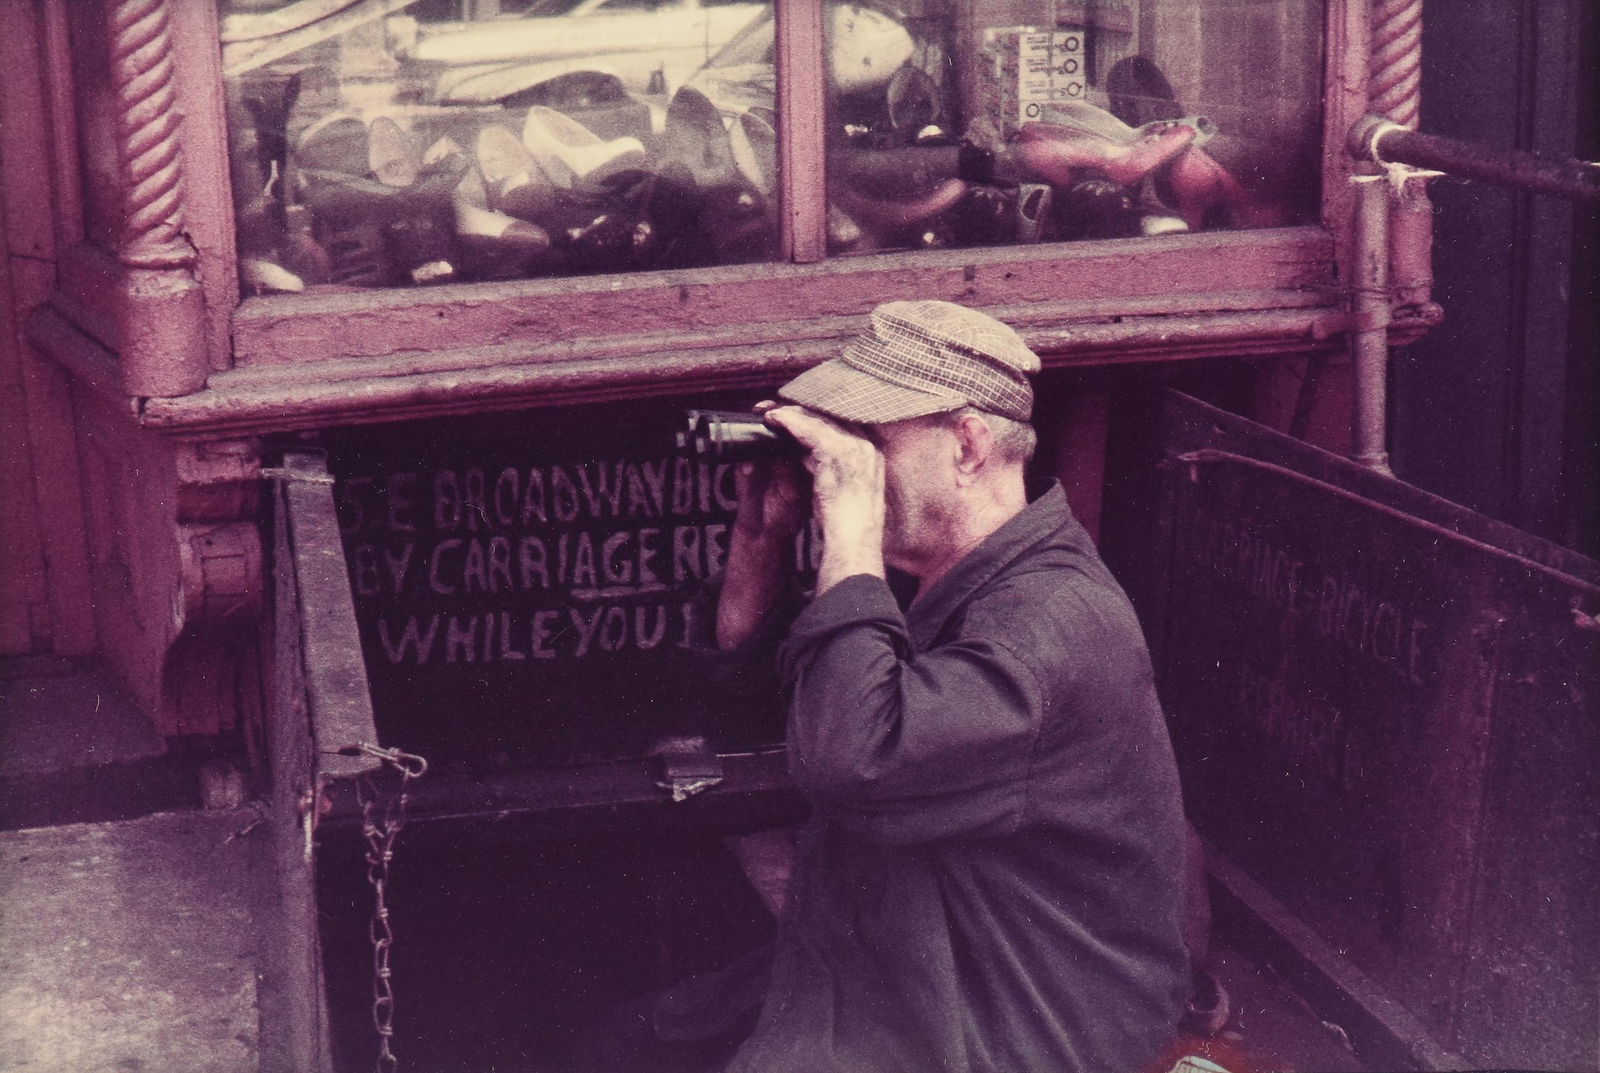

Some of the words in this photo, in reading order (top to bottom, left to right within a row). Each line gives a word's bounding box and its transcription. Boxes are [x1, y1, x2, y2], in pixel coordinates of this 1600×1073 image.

[434, 458, 669, 531] BROADWAY
[355, 541, 415, 596] BY
[429, 527, 660, 594] CARRIAGE
[378, 608, 561, 666] WHILE
[572, 604, 667, 660] YOU
